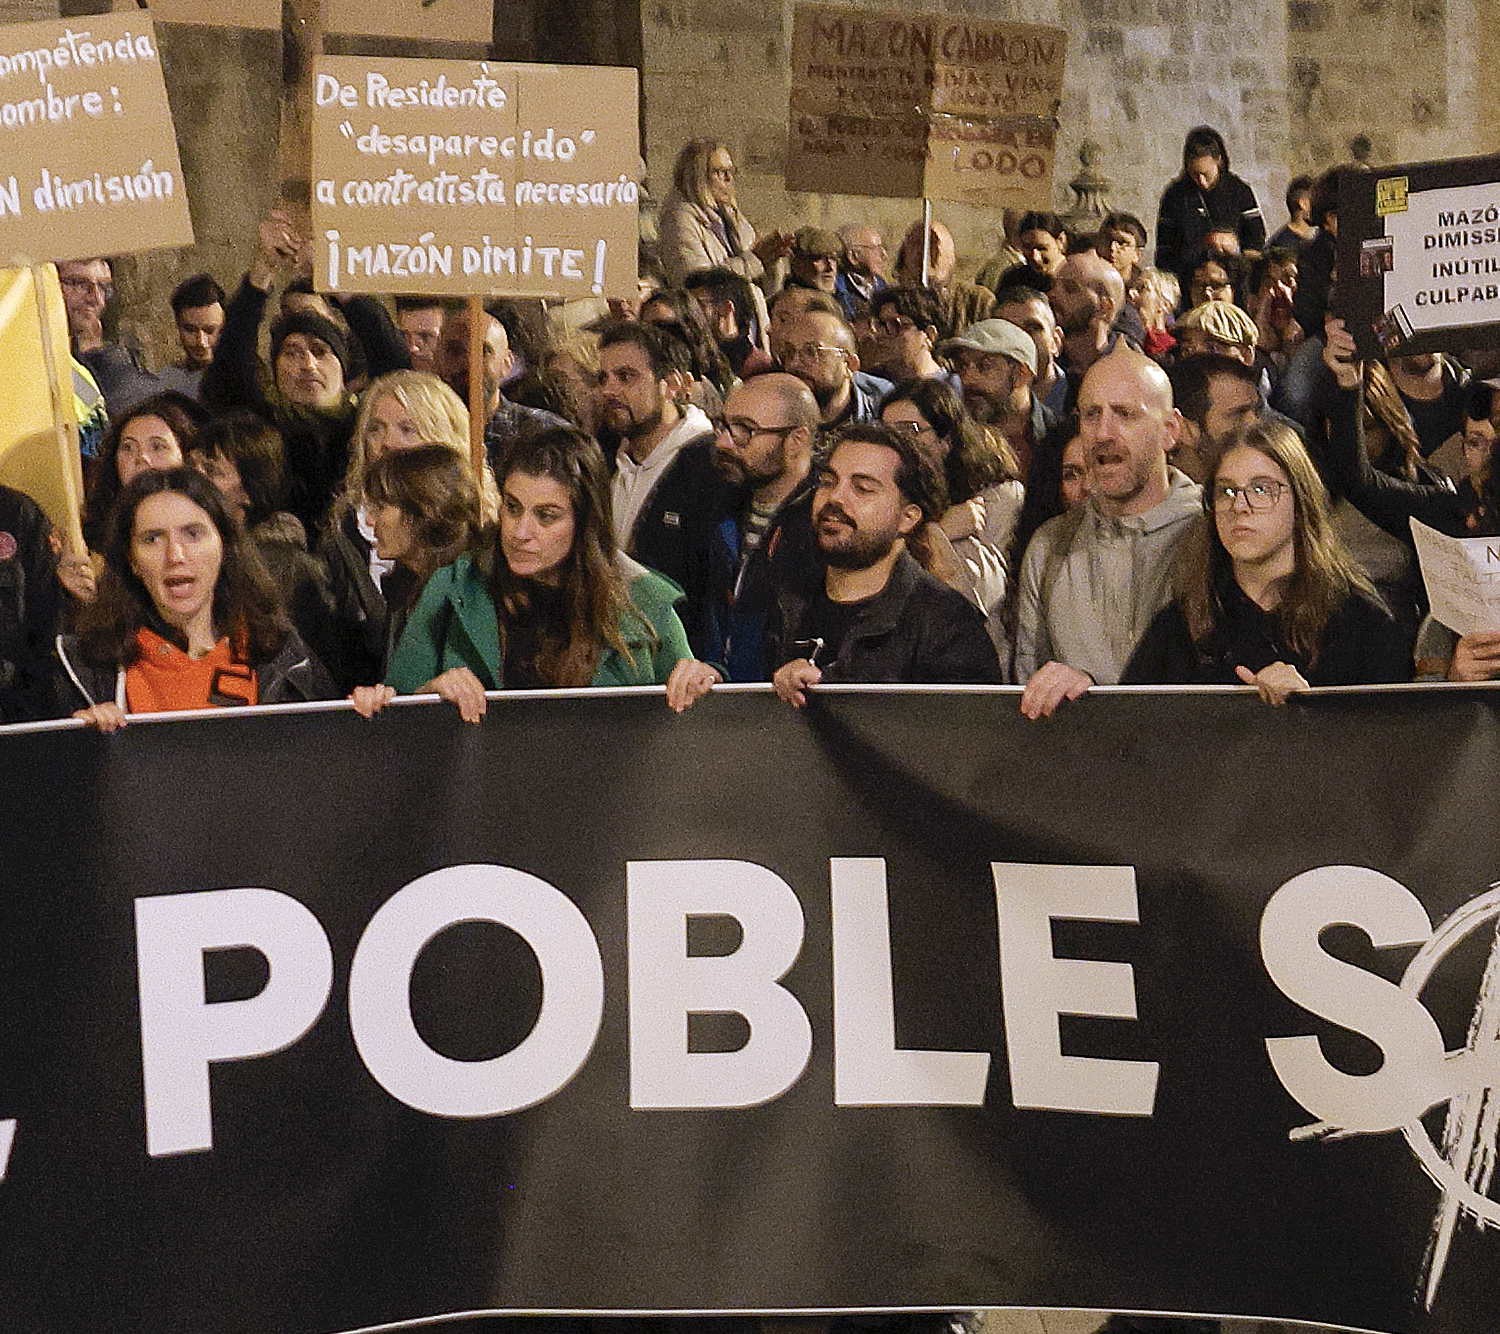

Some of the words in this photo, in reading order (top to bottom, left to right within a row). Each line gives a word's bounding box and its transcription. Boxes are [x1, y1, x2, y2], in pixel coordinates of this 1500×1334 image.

[316, 72, 359, 107] De
[367, 66, 507, 108] Presidente
[953, 145, 1047, 180] LODO
[34, 159, 174, 211] dimisión
[317, 179, 336, 205] a
[343, 168, 507, 206] contratista
[516, 174, 638, 206] necesario
[133, 856, 1162, 1158] POBLE
